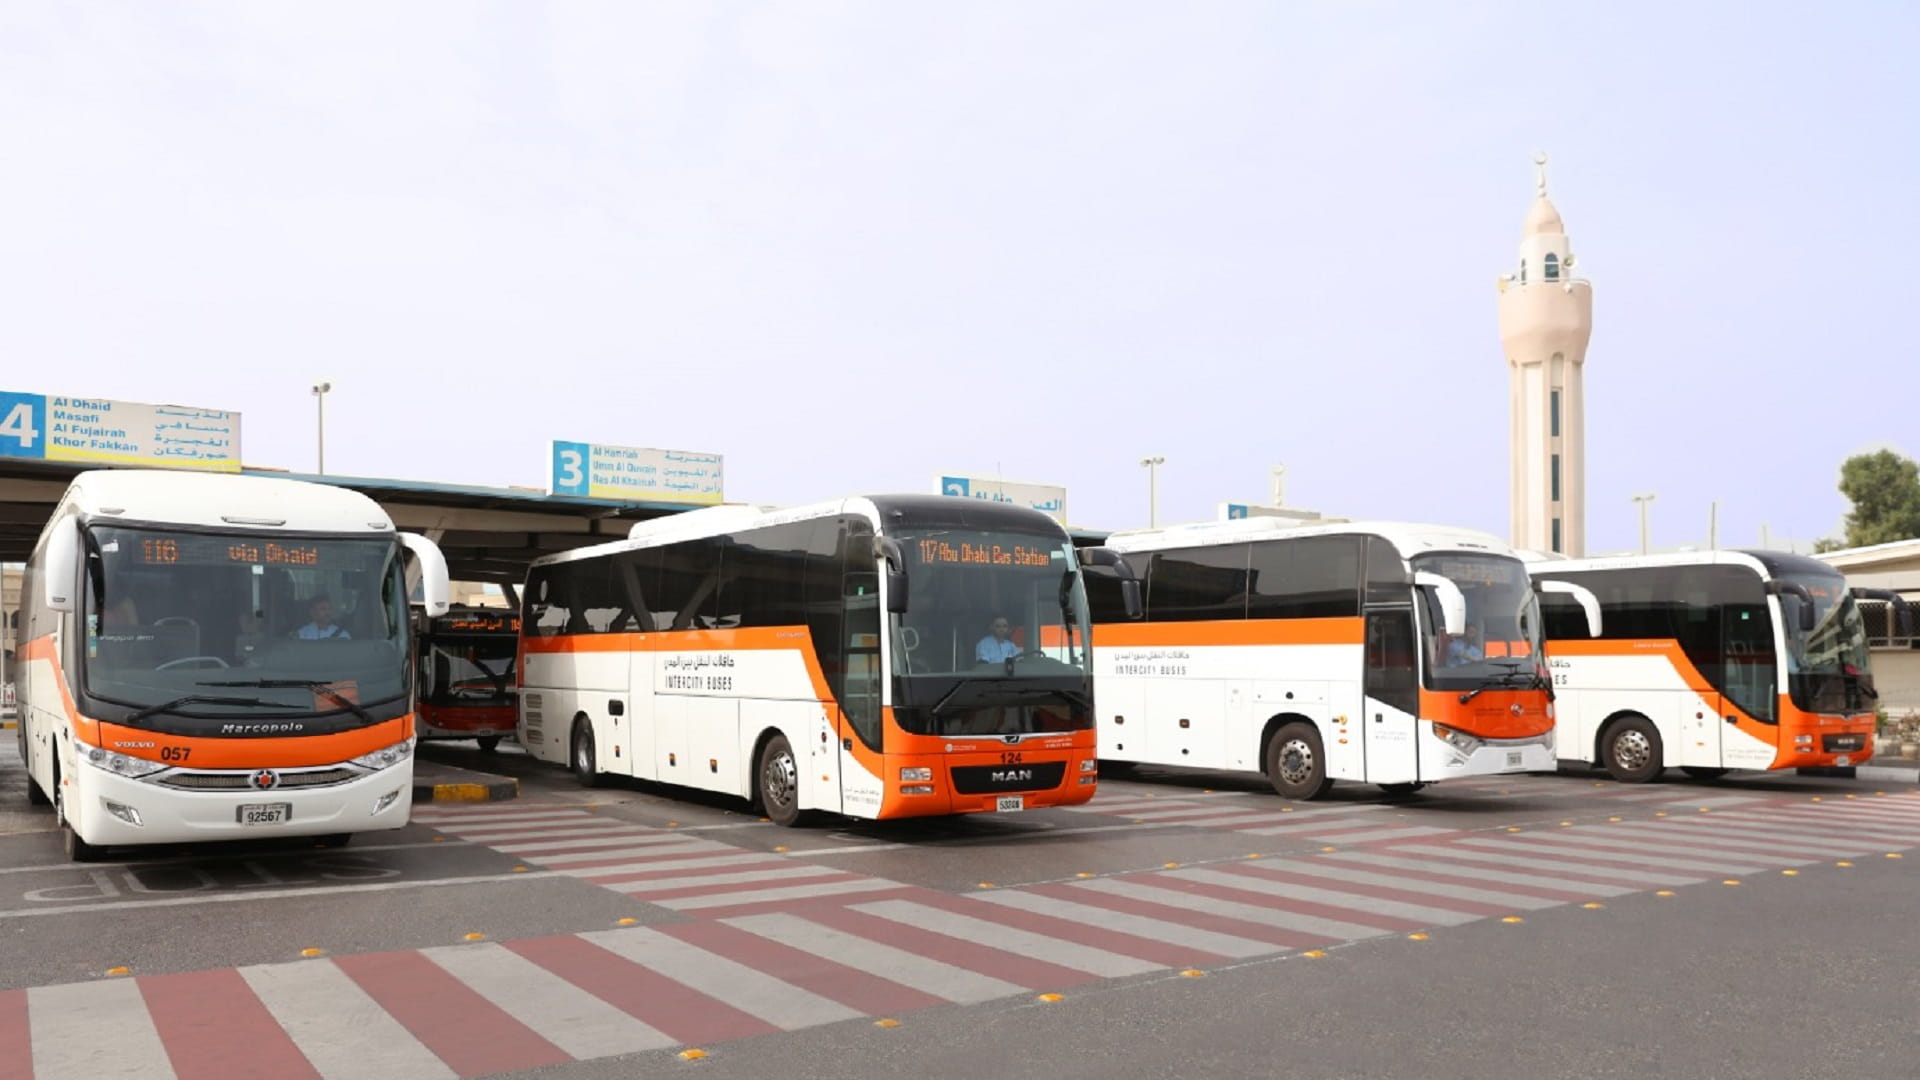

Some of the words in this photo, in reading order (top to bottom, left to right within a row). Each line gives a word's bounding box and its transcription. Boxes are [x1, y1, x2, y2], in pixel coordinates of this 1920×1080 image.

[54, 398, 67, 407] Al
[72, 399, 111, 411] Dhaid
[54, 410, 99, 423] Masafi
[0, 402, 38, 448] 4
[54, 424, 67, 432] Al
[72, 425, 126, 437] Fujairah
[53, 437, 86, 447] Khor
[91, 439, 138, 451] Fakkan
[593, 447, 602, 456] Al
[559, 450, 583, 487] 3
[593, 461, 614, 471] Umm
[616, 462, 625, 471] Al
[593, 474, 608, 484] Ras
[610, 475, 620, 485] Al
[229, 543, 259, 562] via
[265, 543, 318, 564] Dhaid
[939, 542, 958, 562] Abu
[961, 543, 990, 563] Dhabi
[992, 545, 1011, 565] Bus
[1014, 546, 1049, 566] Station
[665, 675, 703, 688] INTERCITY
[707, 676, 732, 690] BUSES
[221, 722, 304, 734] Marcopolo
[114, 741, 155, 749] VOLVO
[160, 746, 192, 761] 057
[1001, 752, 1022, 765] 124
[992, 770, 1032, 781] MAN
[247, 810, 282, 823] 92567
